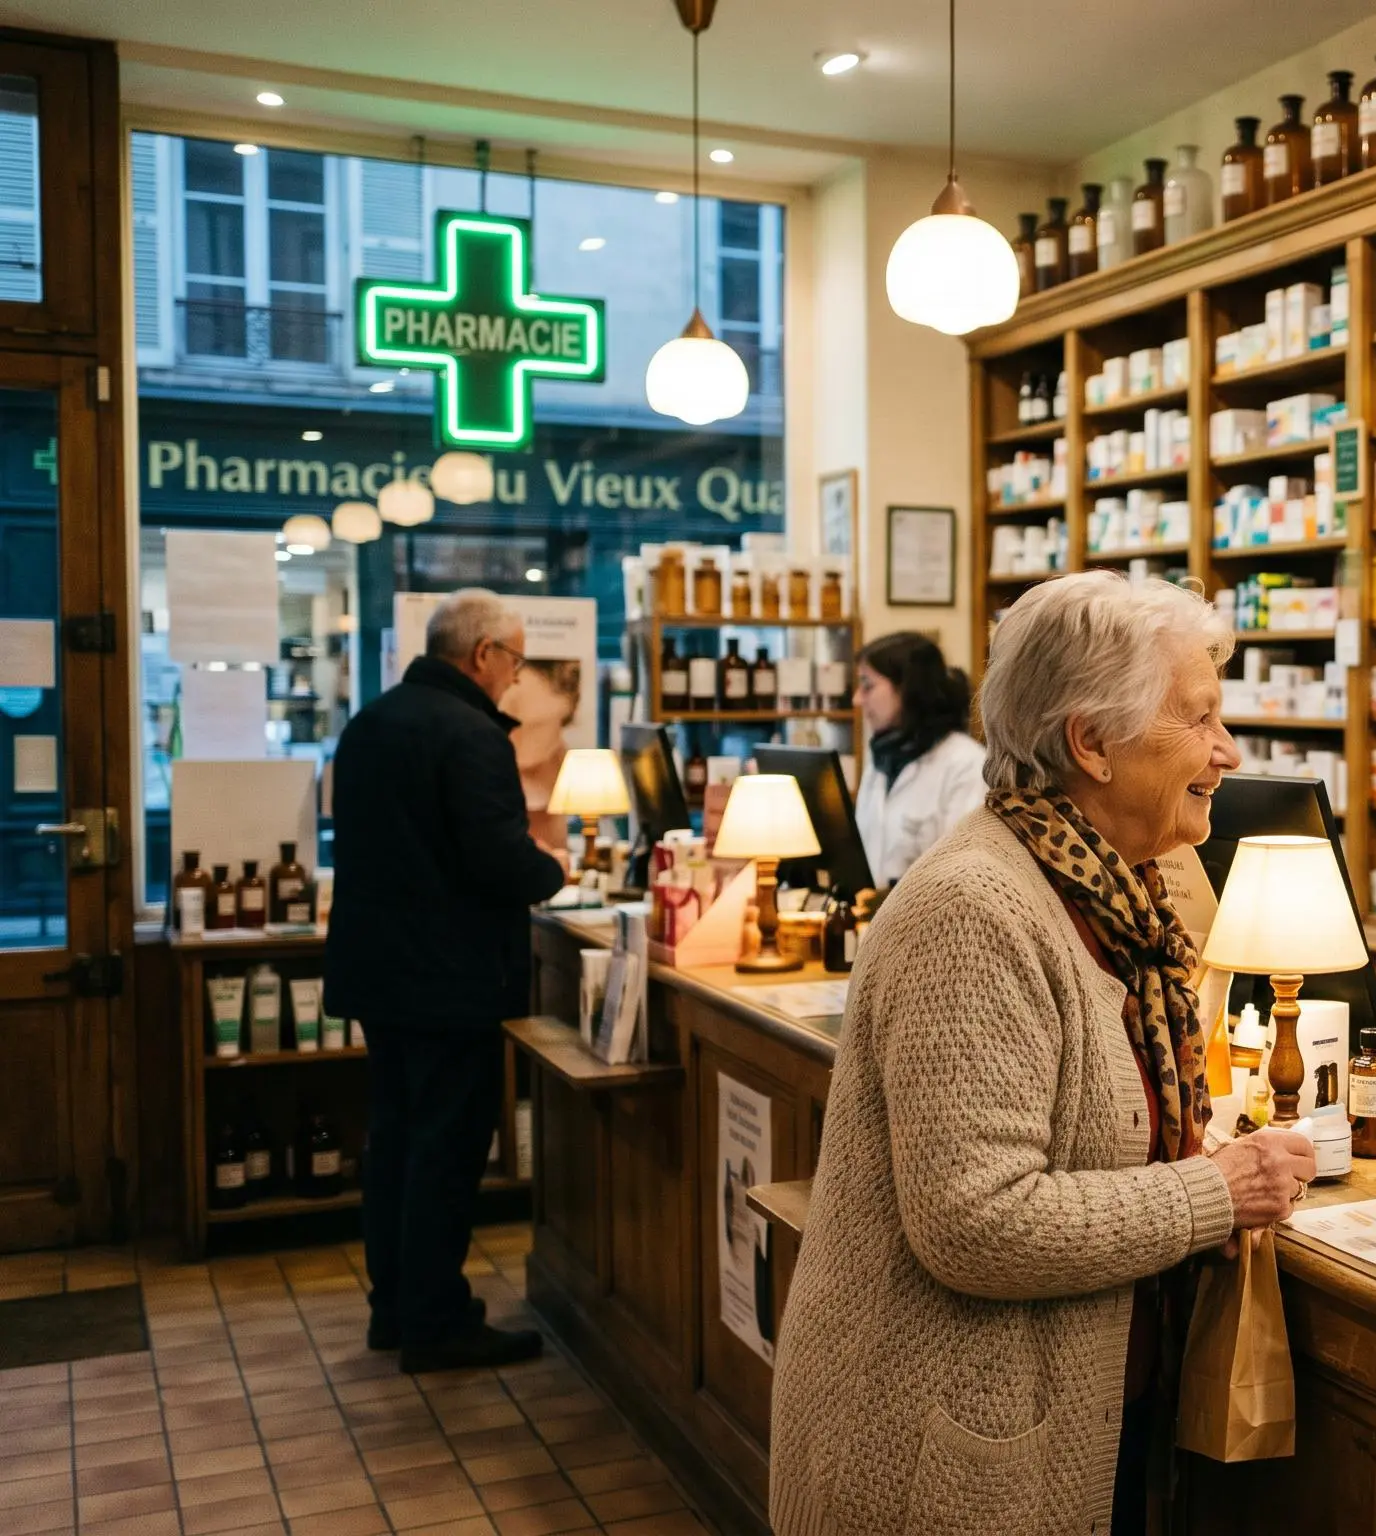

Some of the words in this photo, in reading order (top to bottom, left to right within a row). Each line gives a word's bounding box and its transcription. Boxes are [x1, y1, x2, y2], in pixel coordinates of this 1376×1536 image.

[385, 307, 581, 358] PHARMACIE
[544, 459, 683, 511] Vieux
[697, 466, 785, 523] Qua
